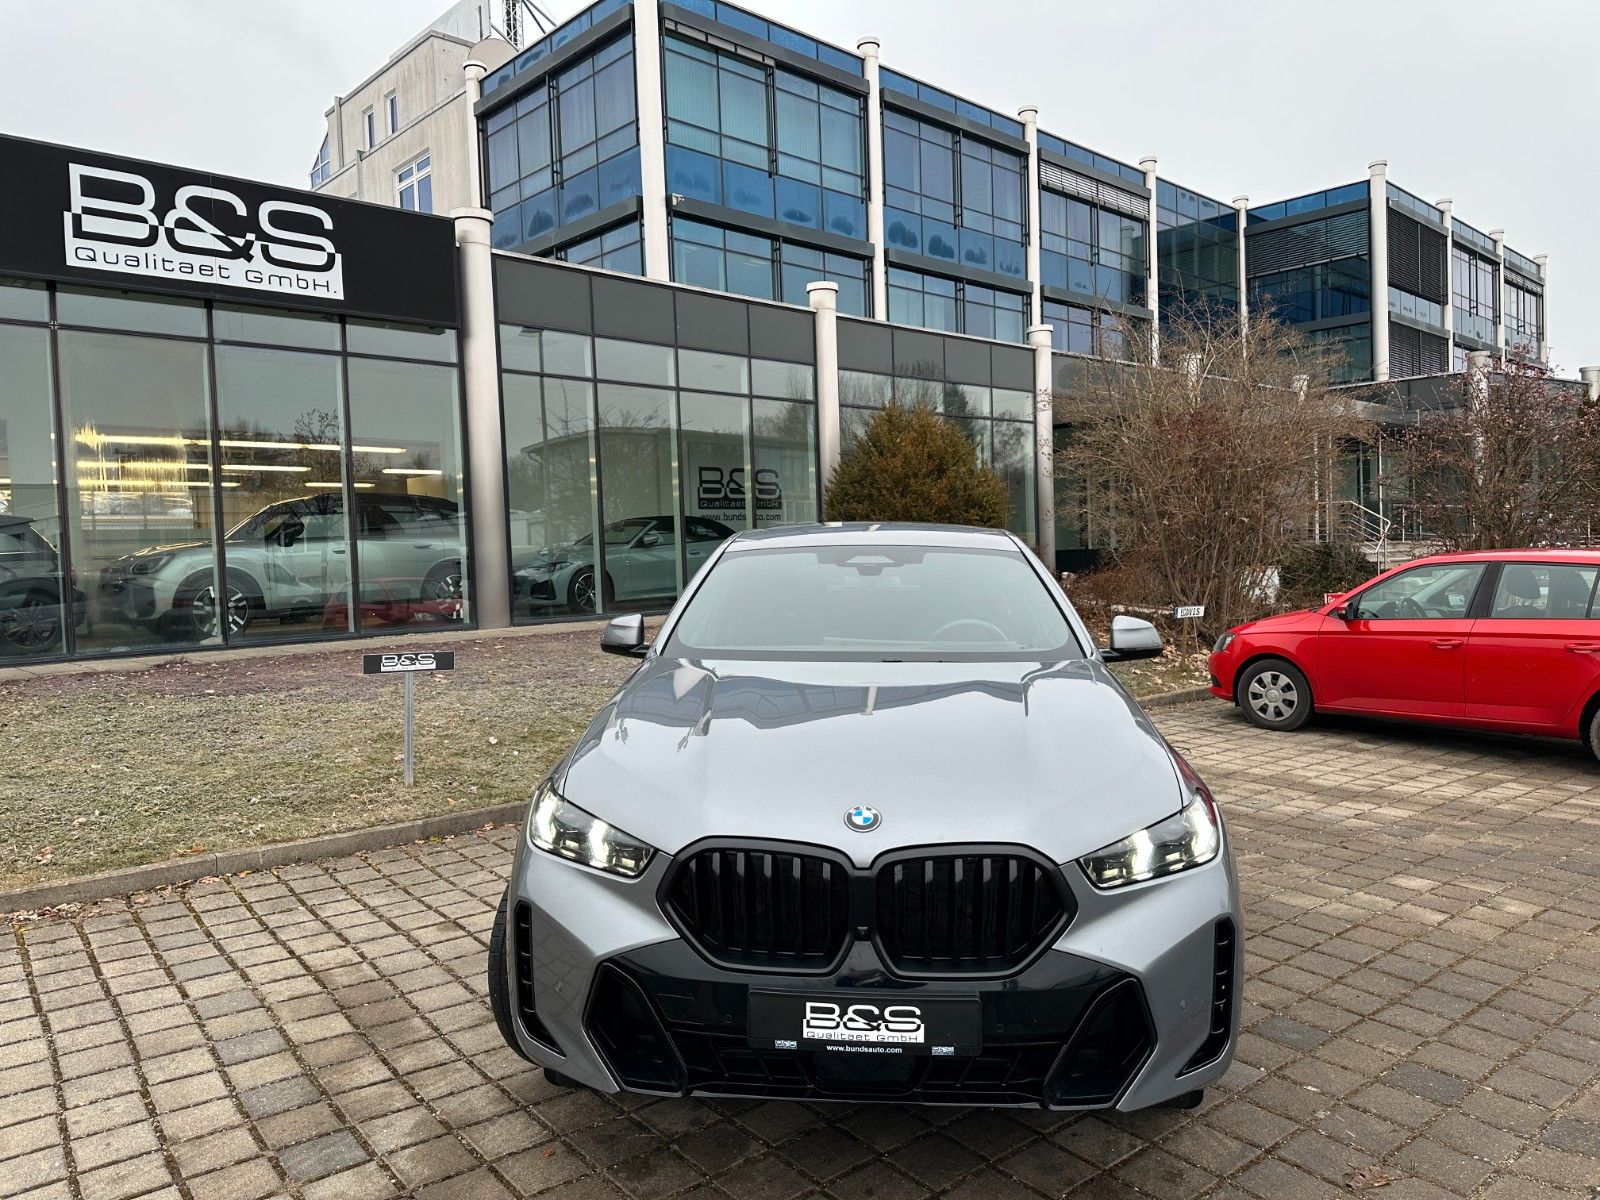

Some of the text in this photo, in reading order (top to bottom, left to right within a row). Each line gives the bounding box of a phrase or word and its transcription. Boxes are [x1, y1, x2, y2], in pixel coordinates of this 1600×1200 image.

[69, 163, 336, 273] B&S
[74, 246, 338, 294] Qualitaet GmbH.
[698, 466, 780, 499] B&S
[382, 653, 435, 667] B&S
[805, 1001, 922, 1033] B&S
[806, 1031, 871, 1041] Qualitaet
[826, 1044, 903, 1054] www.bundsauto.com
